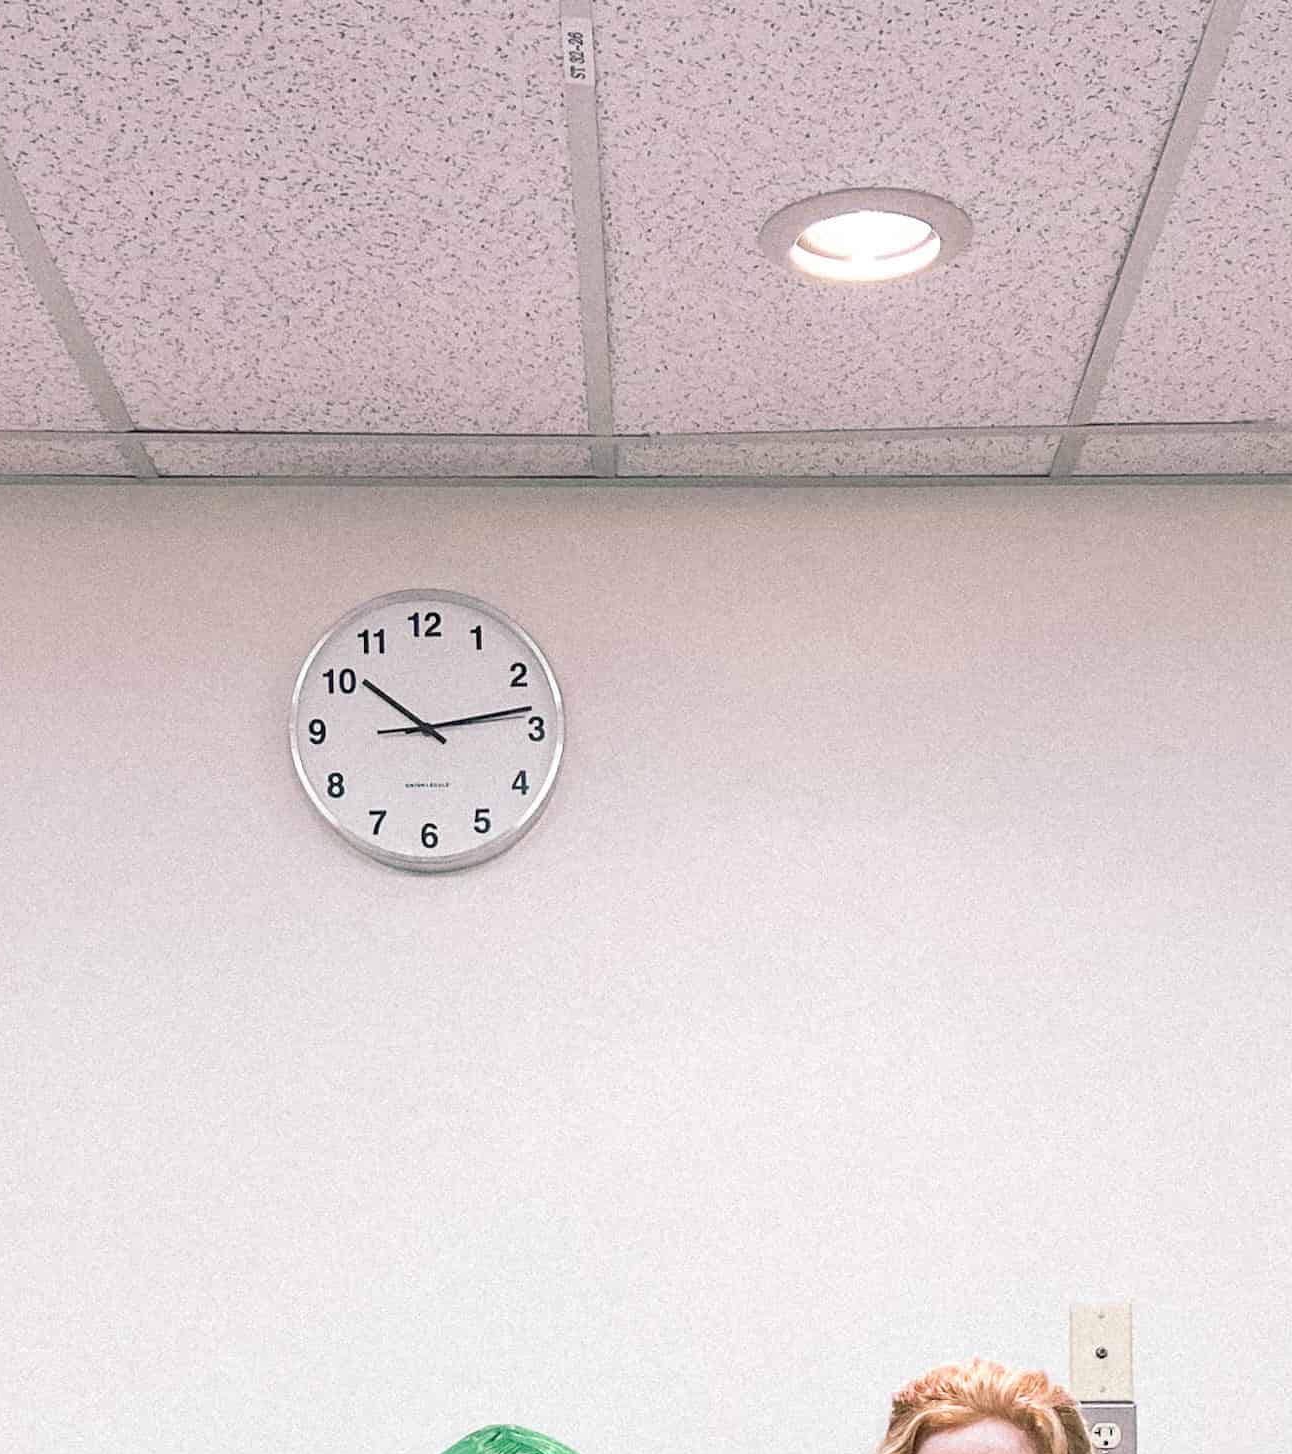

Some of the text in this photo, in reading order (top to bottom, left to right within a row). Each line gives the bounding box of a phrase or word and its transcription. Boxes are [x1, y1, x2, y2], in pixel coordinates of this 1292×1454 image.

[570, 65, 586, 80] ST
[407, 611, 443, 638] 12
[357, 629, 386, 654] 11
[470, 625, 484, 651] 1
[322, 668, 357, 694] 10
[509, 662, 528, 688] 2
[308, 718, 327, 745] 9
[527, 716, 546, 742] 3
[326, 772, 345, 799] 8
[511, 769, 530, 796] 4
[368, 810, 388, 835] 7
[473, 808, 492, 834] 5
[420, 823, 439, 849] 6
